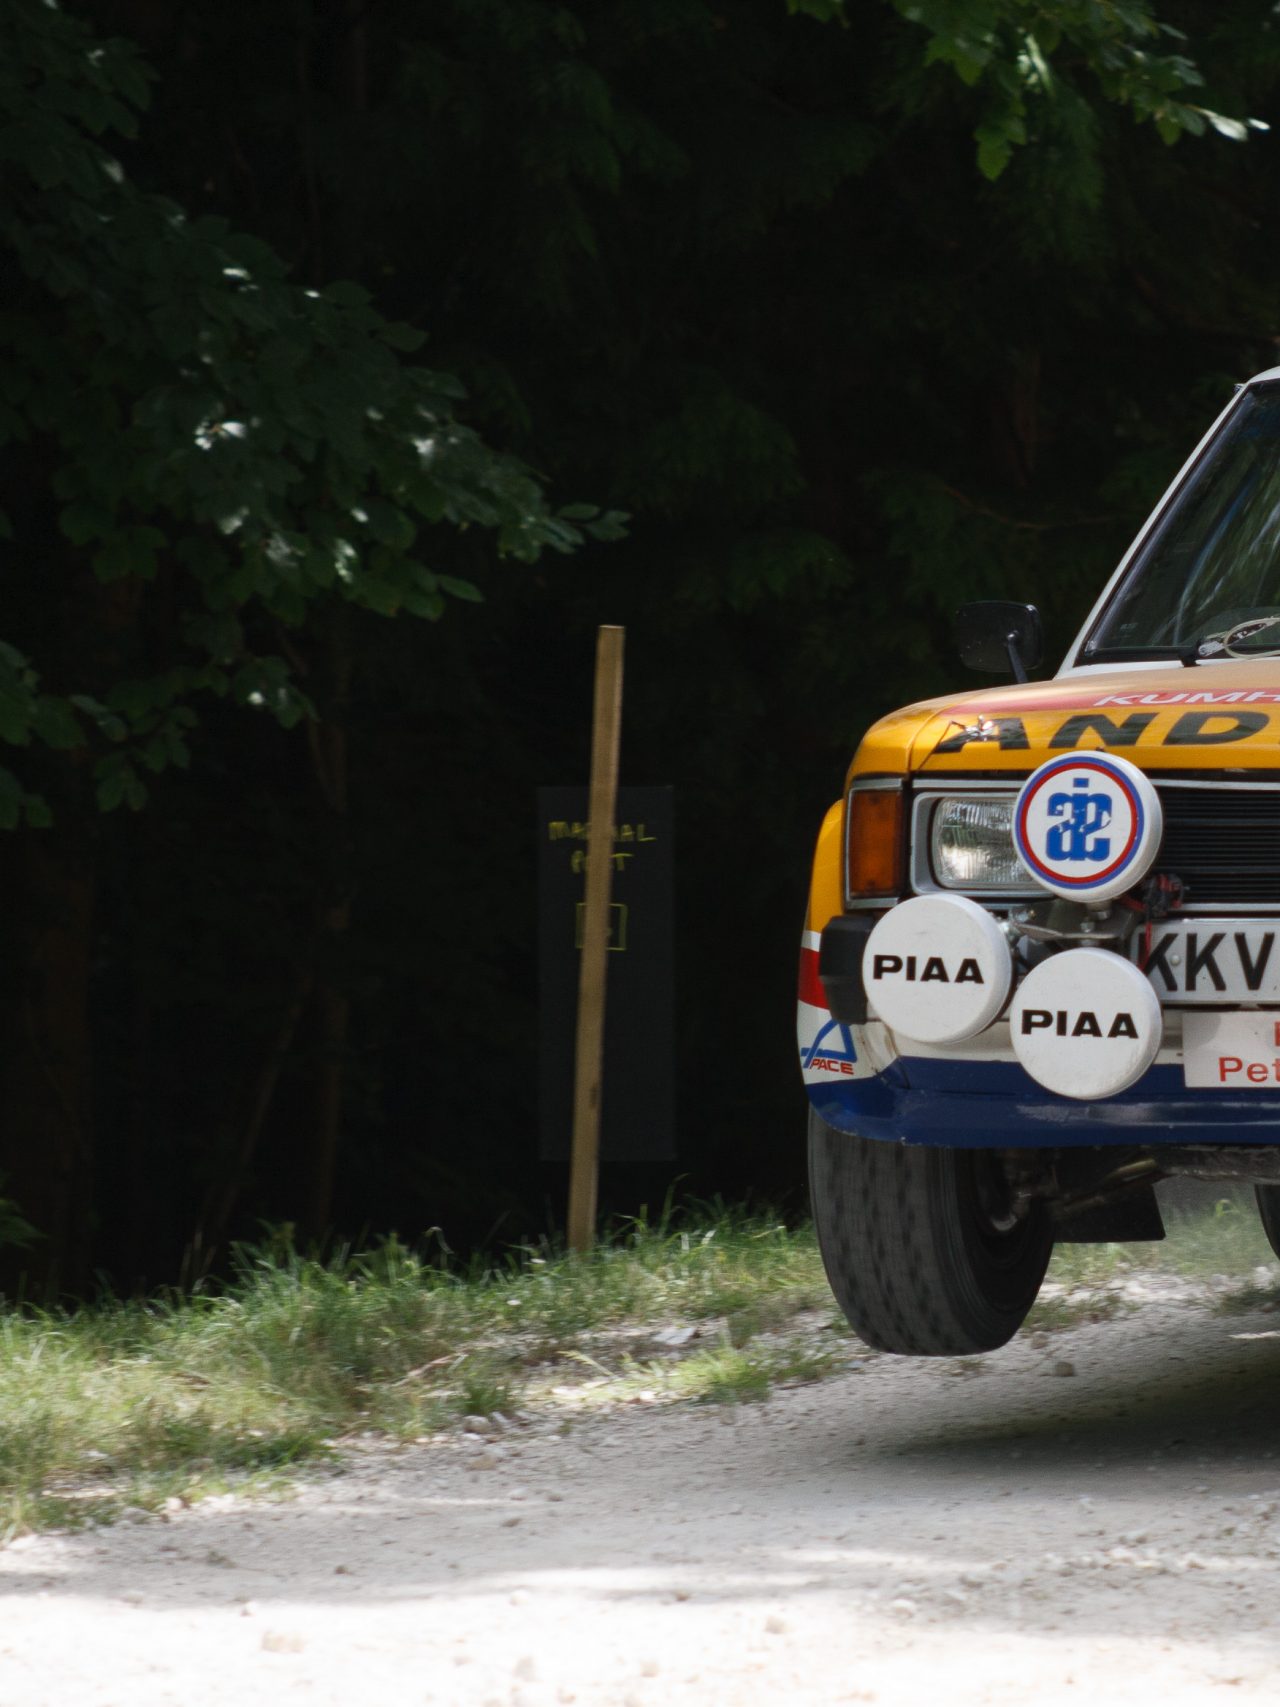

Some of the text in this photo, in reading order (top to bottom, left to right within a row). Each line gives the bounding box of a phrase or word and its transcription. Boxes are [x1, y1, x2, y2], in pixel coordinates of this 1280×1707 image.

[570, 850, 634, 873] PT
[873, 954, 984, 984] PIAA
[1138, 931, 1276, 992] KKV
[1021, 1008, 1139, 1039] PIAA
[808, 1057, 855, 1075] PACE
